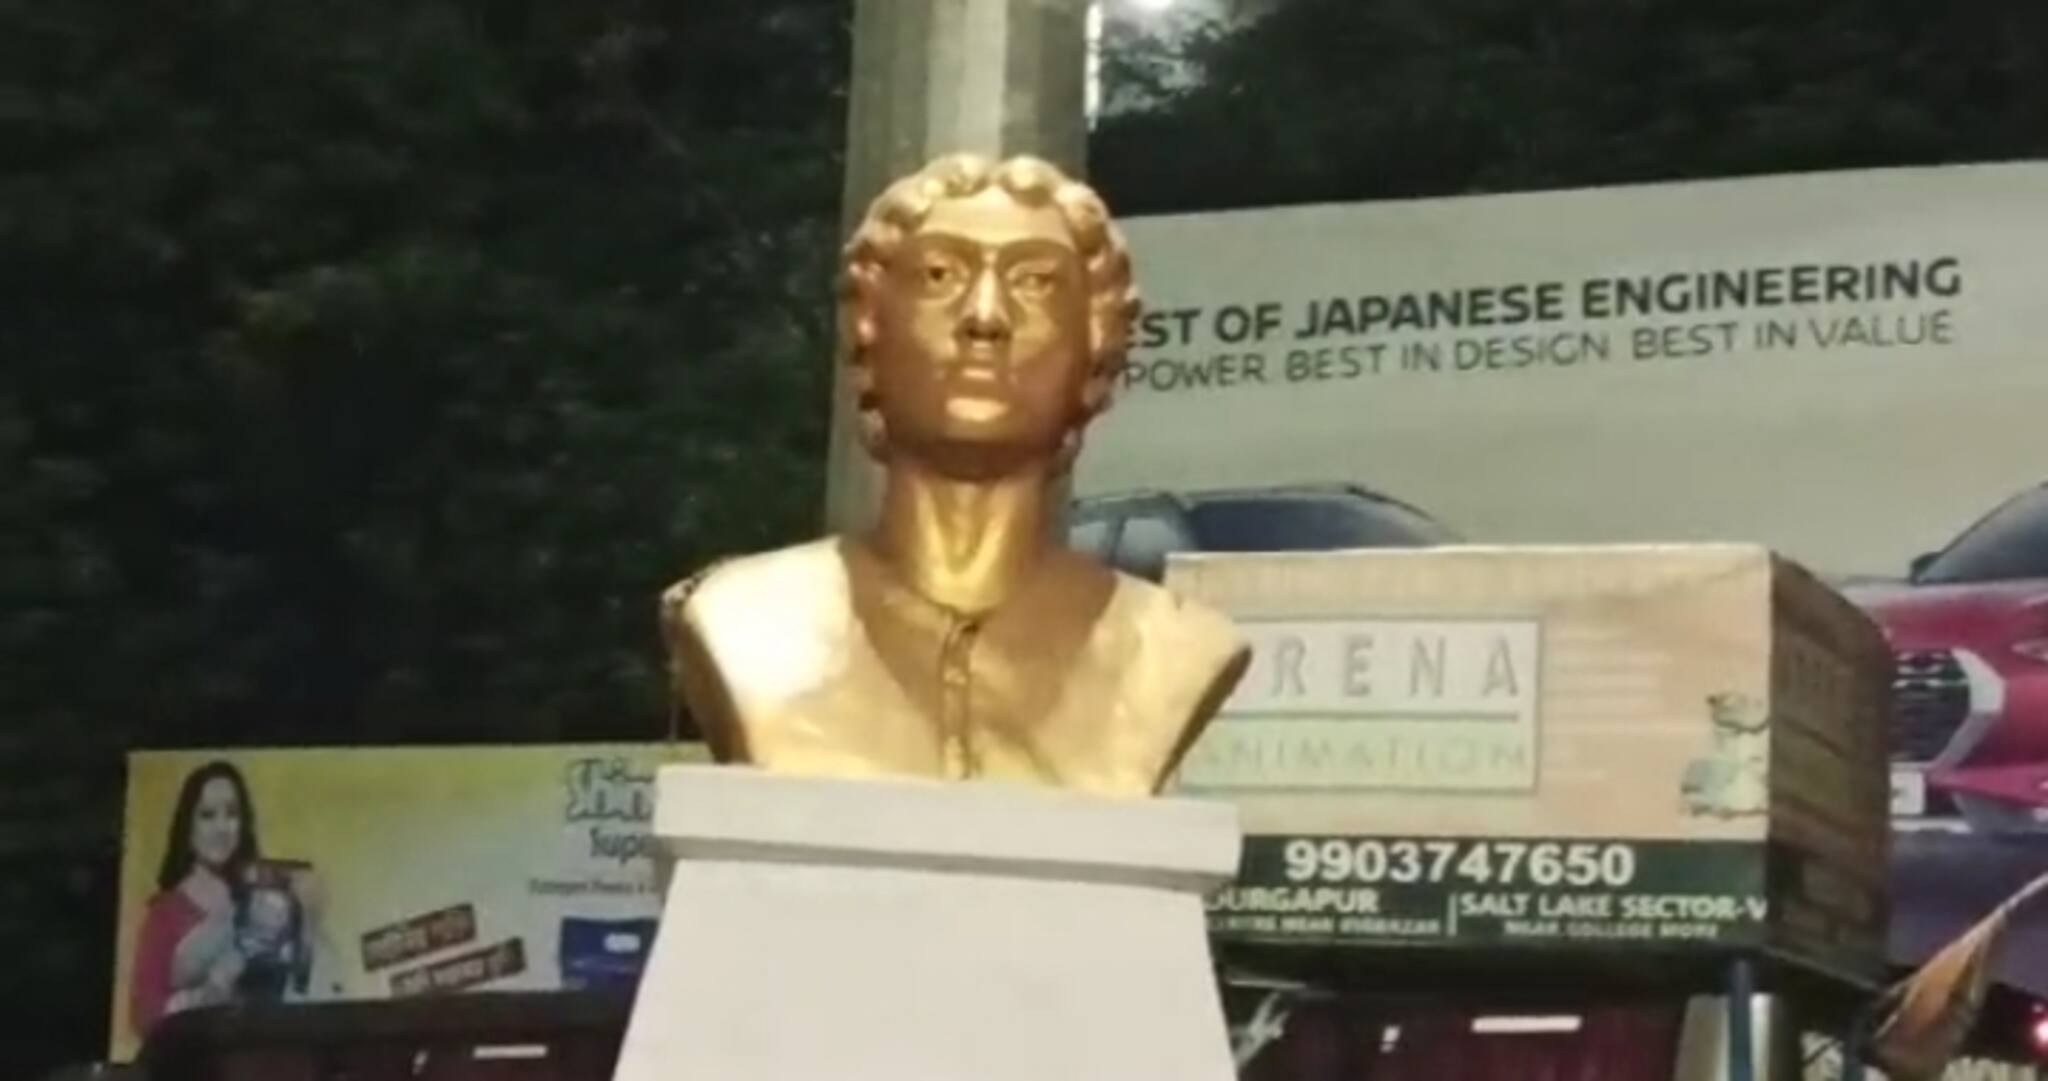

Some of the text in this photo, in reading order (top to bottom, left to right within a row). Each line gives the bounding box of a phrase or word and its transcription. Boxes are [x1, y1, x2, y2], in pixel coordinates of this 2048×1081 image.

[1214, 304, 1282, 343] OF
[1296, 282, 1564, 339] JAPANESE
[1582, 256, 1961, 318] ENGINEERING
[1285, 344, 1387, 382] BEST
[1402, 341, 1441, 371] IN
[1454, 331, 1610, 371] DESIGN
[1632, 320, 1738, 360] BEST
[1754, 320, 1796, 350] IN
[1808, 309, 1954, 348] VALUE
[1284, 839, 1636, 885] 9903747650
[1460, 892, 1767, 921] SALT LAKE SECTOR-V
